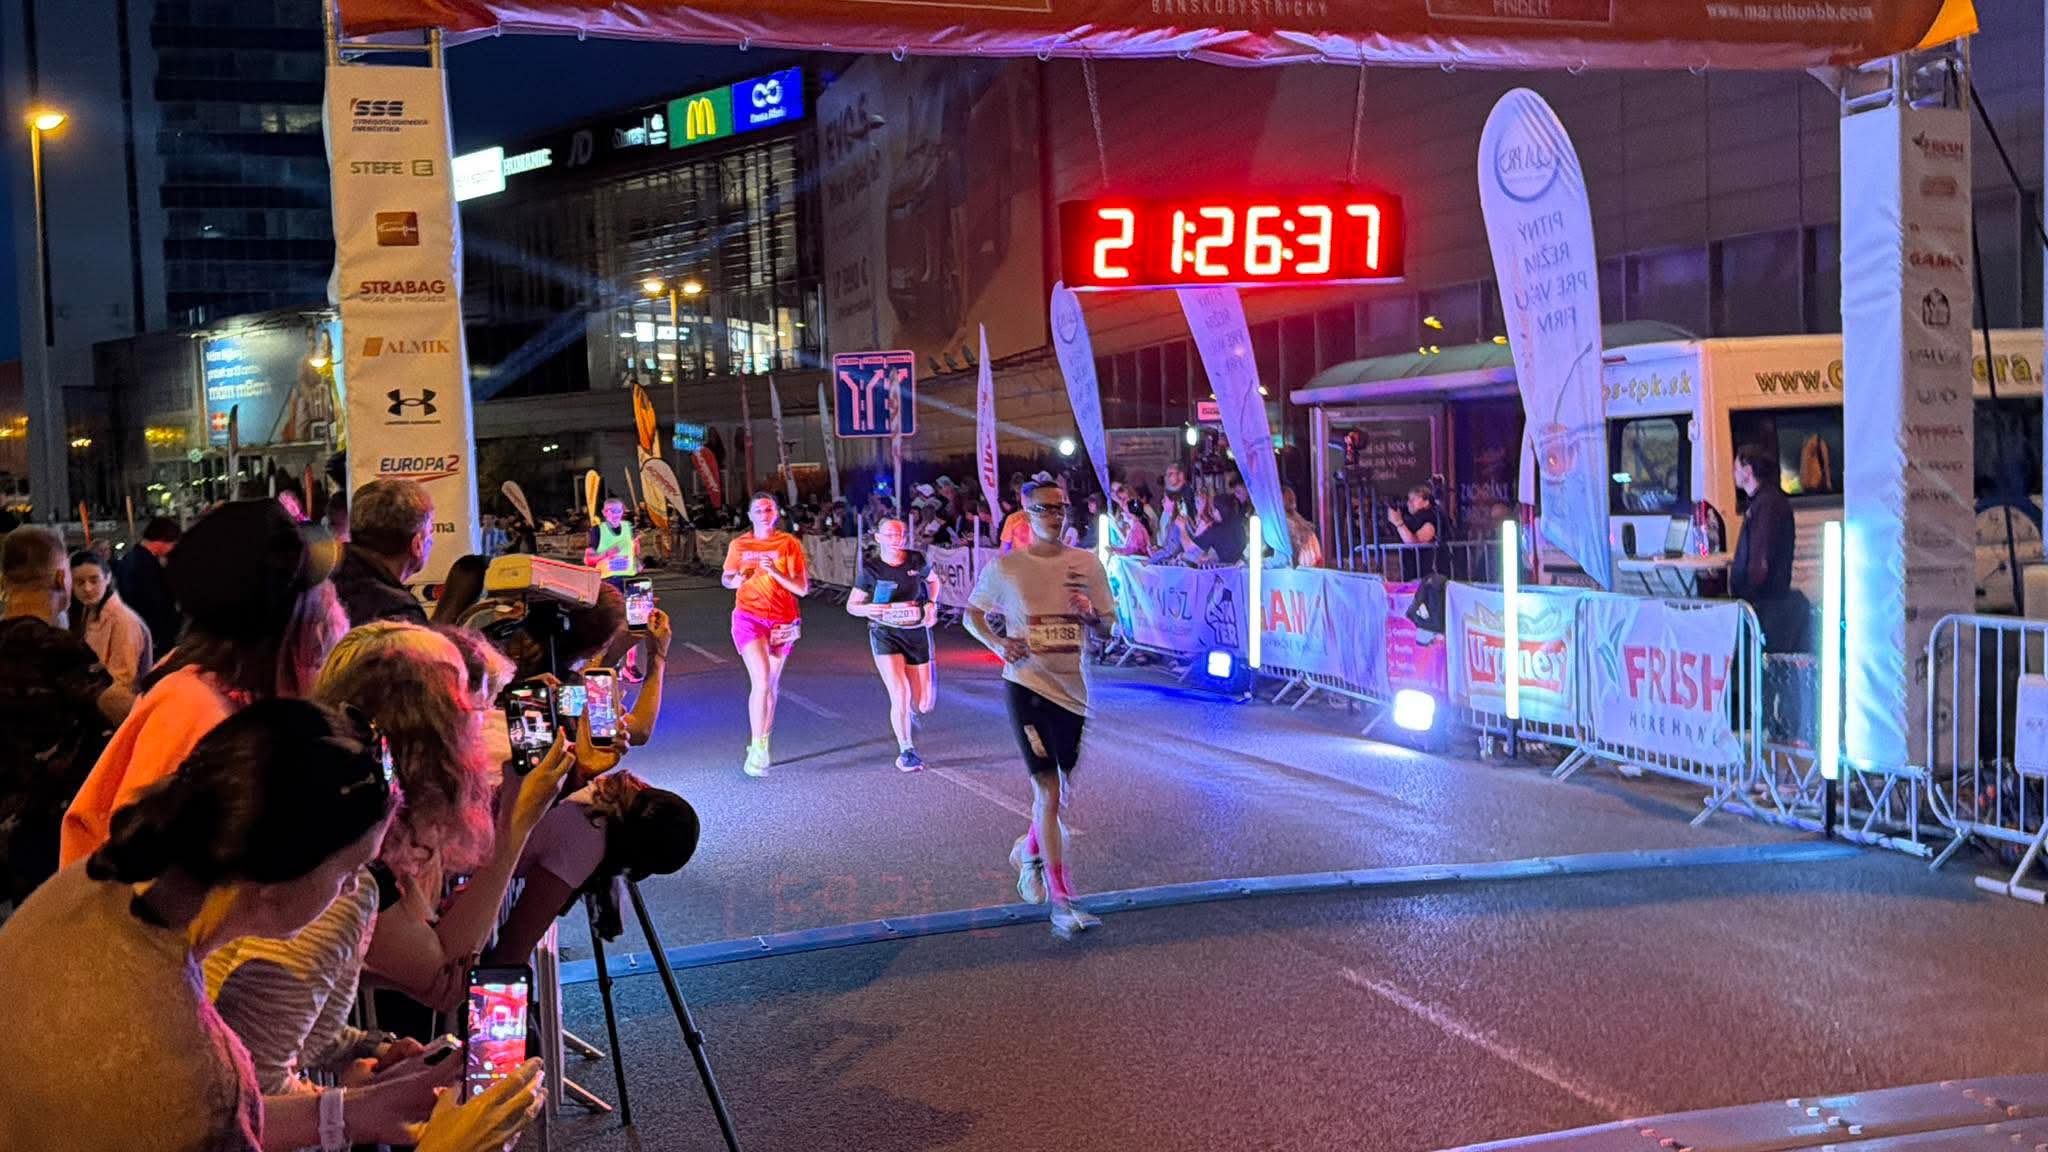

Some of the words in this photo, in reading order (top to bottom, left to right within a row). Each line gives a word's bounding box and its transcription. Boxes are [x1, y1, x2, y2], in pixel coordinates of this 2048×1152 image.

[350, 162, 404, 175] STEFE
[360, 279, 447, 295] STRABAG
[386, 338, 449, 354] ALMIK
[1623, 645, 1731, 713] FRISH
